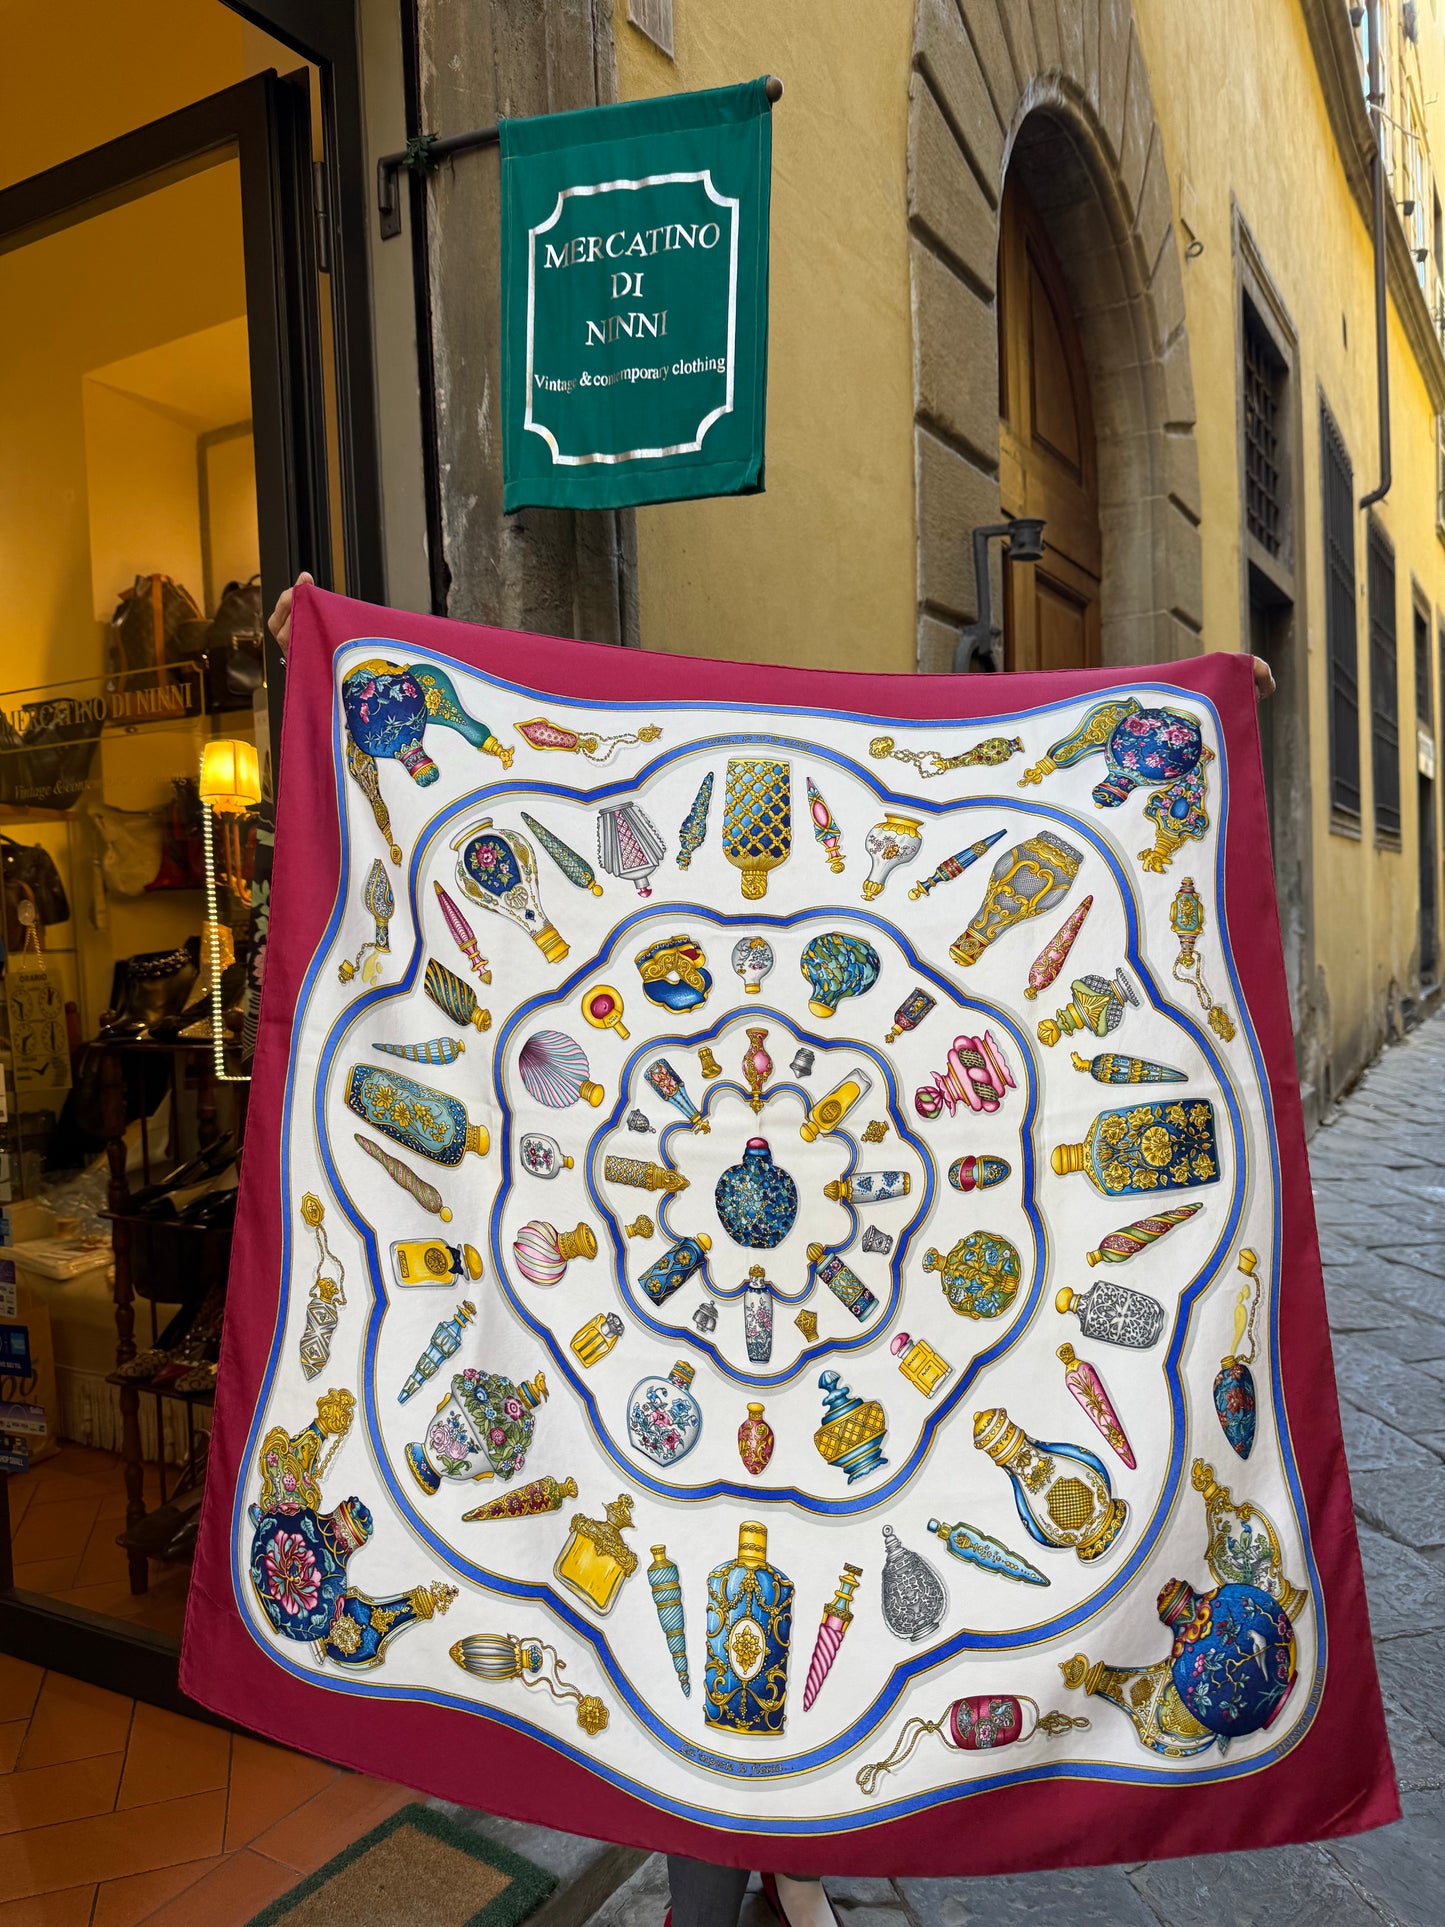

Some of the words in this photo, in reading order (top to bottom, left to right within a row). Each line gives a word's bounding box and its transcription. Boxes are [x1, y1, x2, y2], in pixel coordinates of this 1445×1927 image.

[544, 223, 721, 269] MERCATINO
[610, 272, 645, 300] DI
[585, 310, 668, 346] NINNI
[672, 356, 726, 376] clothing
[111, 691, 132, 719] DI
[136, 682, 193, 716] NINNI
